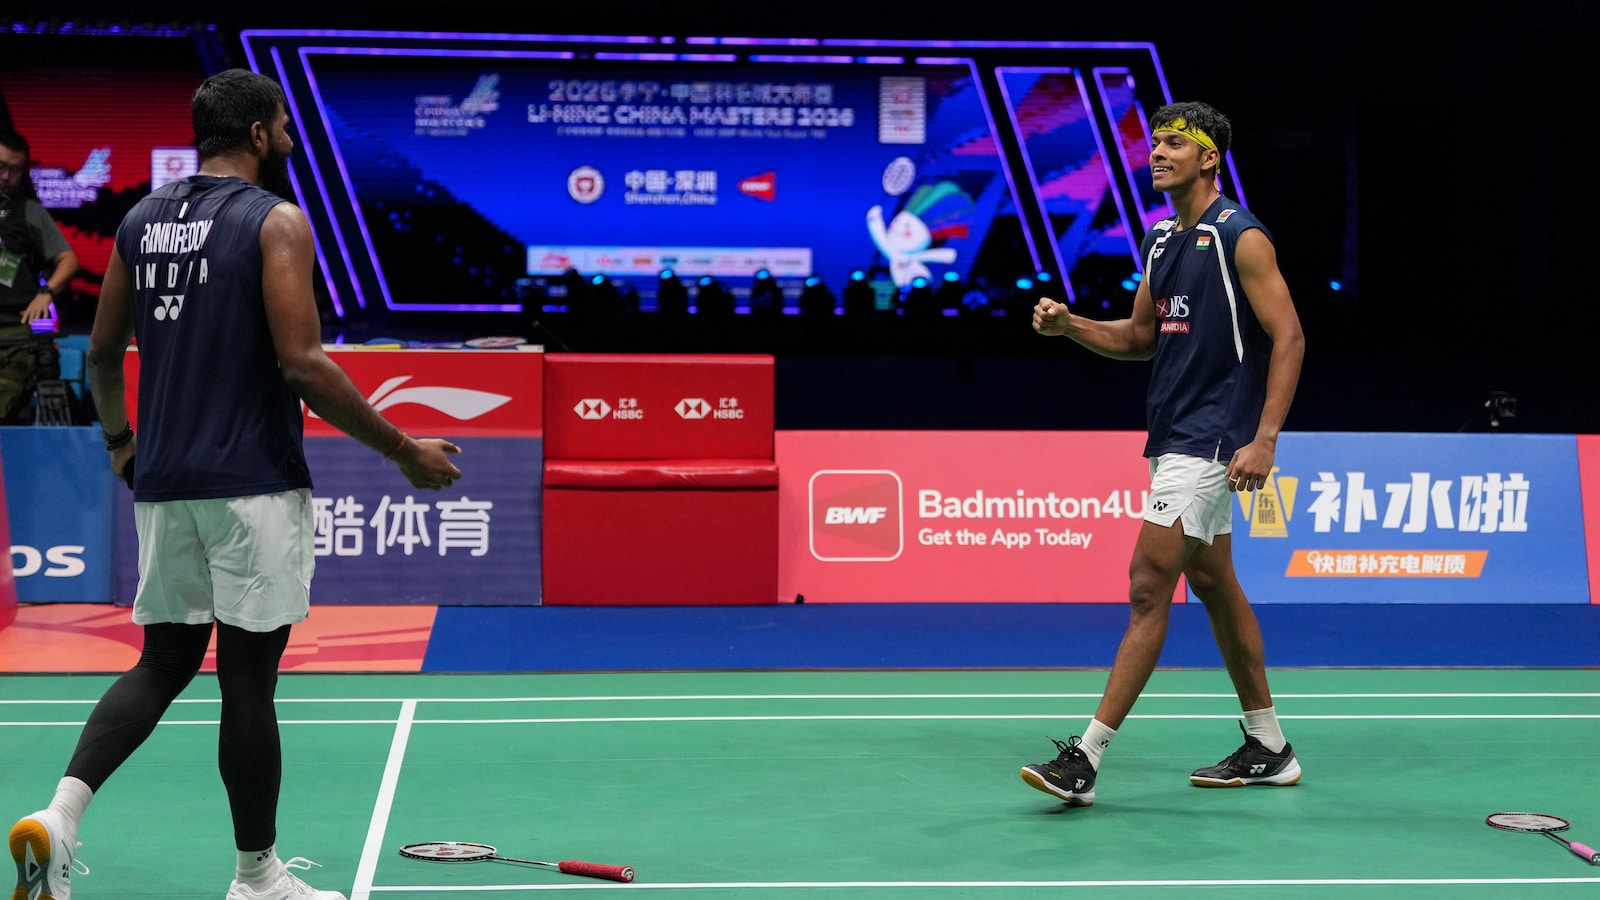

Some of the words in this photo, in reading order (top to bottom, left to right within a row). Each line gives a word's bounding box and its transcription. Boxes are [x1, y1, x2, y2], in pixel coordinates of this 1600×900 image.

[135, 258, 208, 290] INDIA
[612, 409, 643, 420] HSBC
[713, 409, 744, 420] HSBC
[918, 489, 1148, 519] Badminton4U
[1307, 472, 1530, 534] 补水啦
[312, 495, 493, 557] 酷体育
[825, 506, 887, 525] BWF
[918, 529, 952, 546] Get
[955, 528, 987, 546] the
[990, 528, 1031, 549] App
[1035, 528, 1092, 549] Today
[1314, 554, 1467, 575] 快速补充电解质
